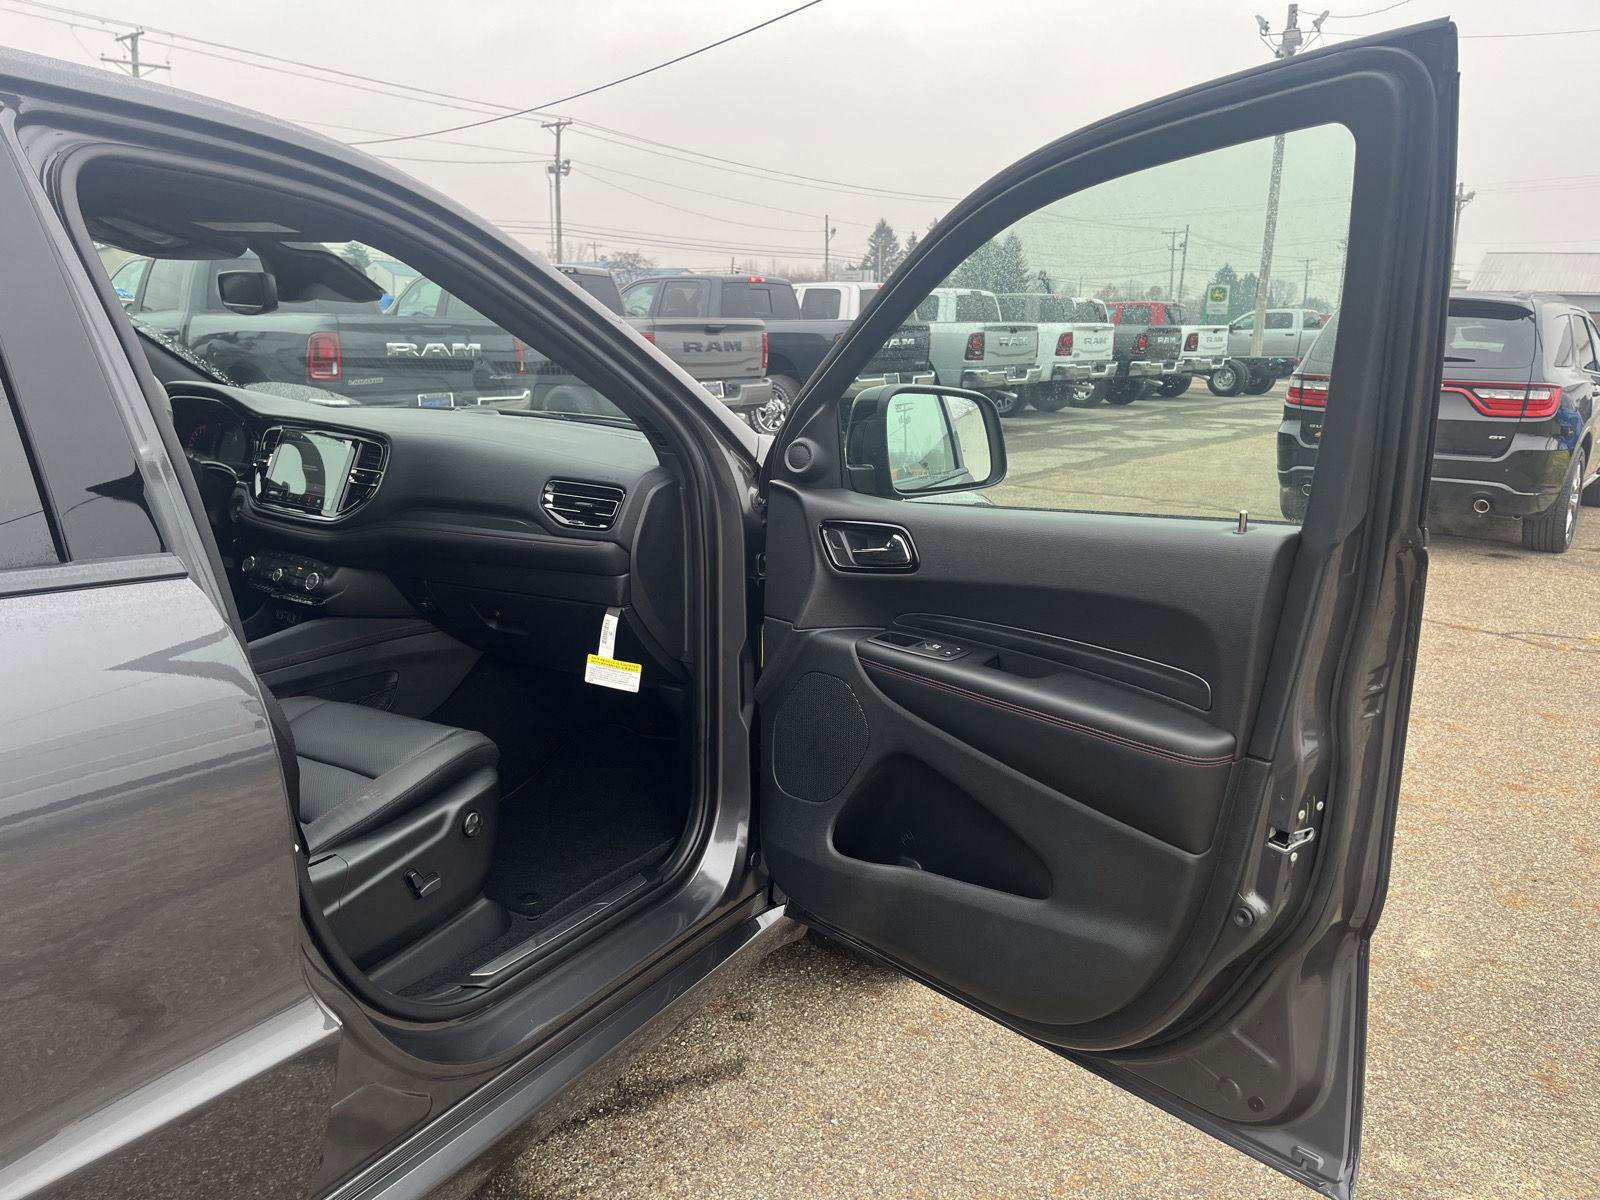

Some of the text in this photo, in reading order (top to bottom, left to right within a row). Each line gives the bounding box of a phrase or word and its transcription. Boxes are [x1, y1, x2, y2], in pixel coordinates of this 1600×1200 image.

[999, 337, 1028, 346] RAM
[1084, 336, 1106, 345] RAM
[386, 342, 481, 357] RAM
[683, 341, 742, 353] RAM
